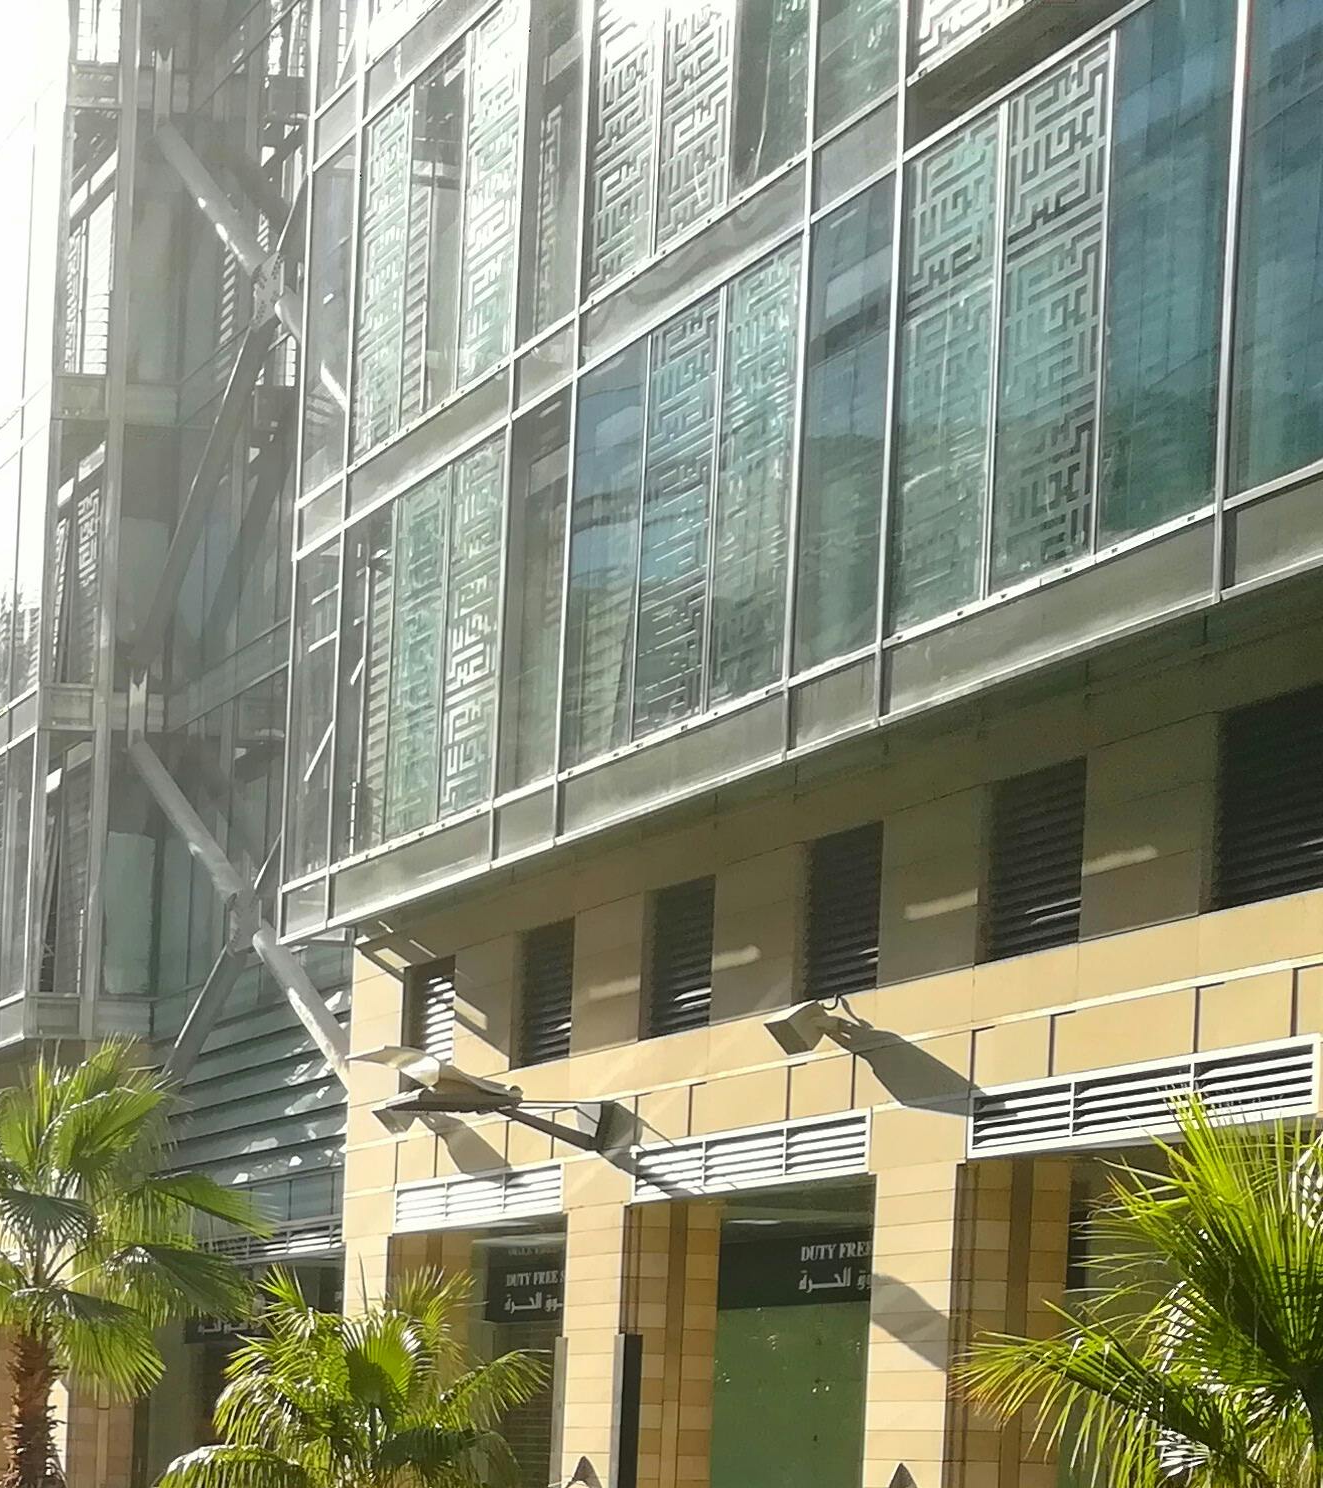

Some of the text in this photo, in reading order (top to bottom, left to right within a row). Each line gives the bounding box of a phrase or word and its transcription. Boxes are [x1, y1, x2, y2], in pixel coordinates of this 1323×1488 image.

[800, 1244, 837, 1262] DUTY
[506, 1270, 559, 1287] DUTY FREE
[798, 1267, 852, 1293] الحرة
